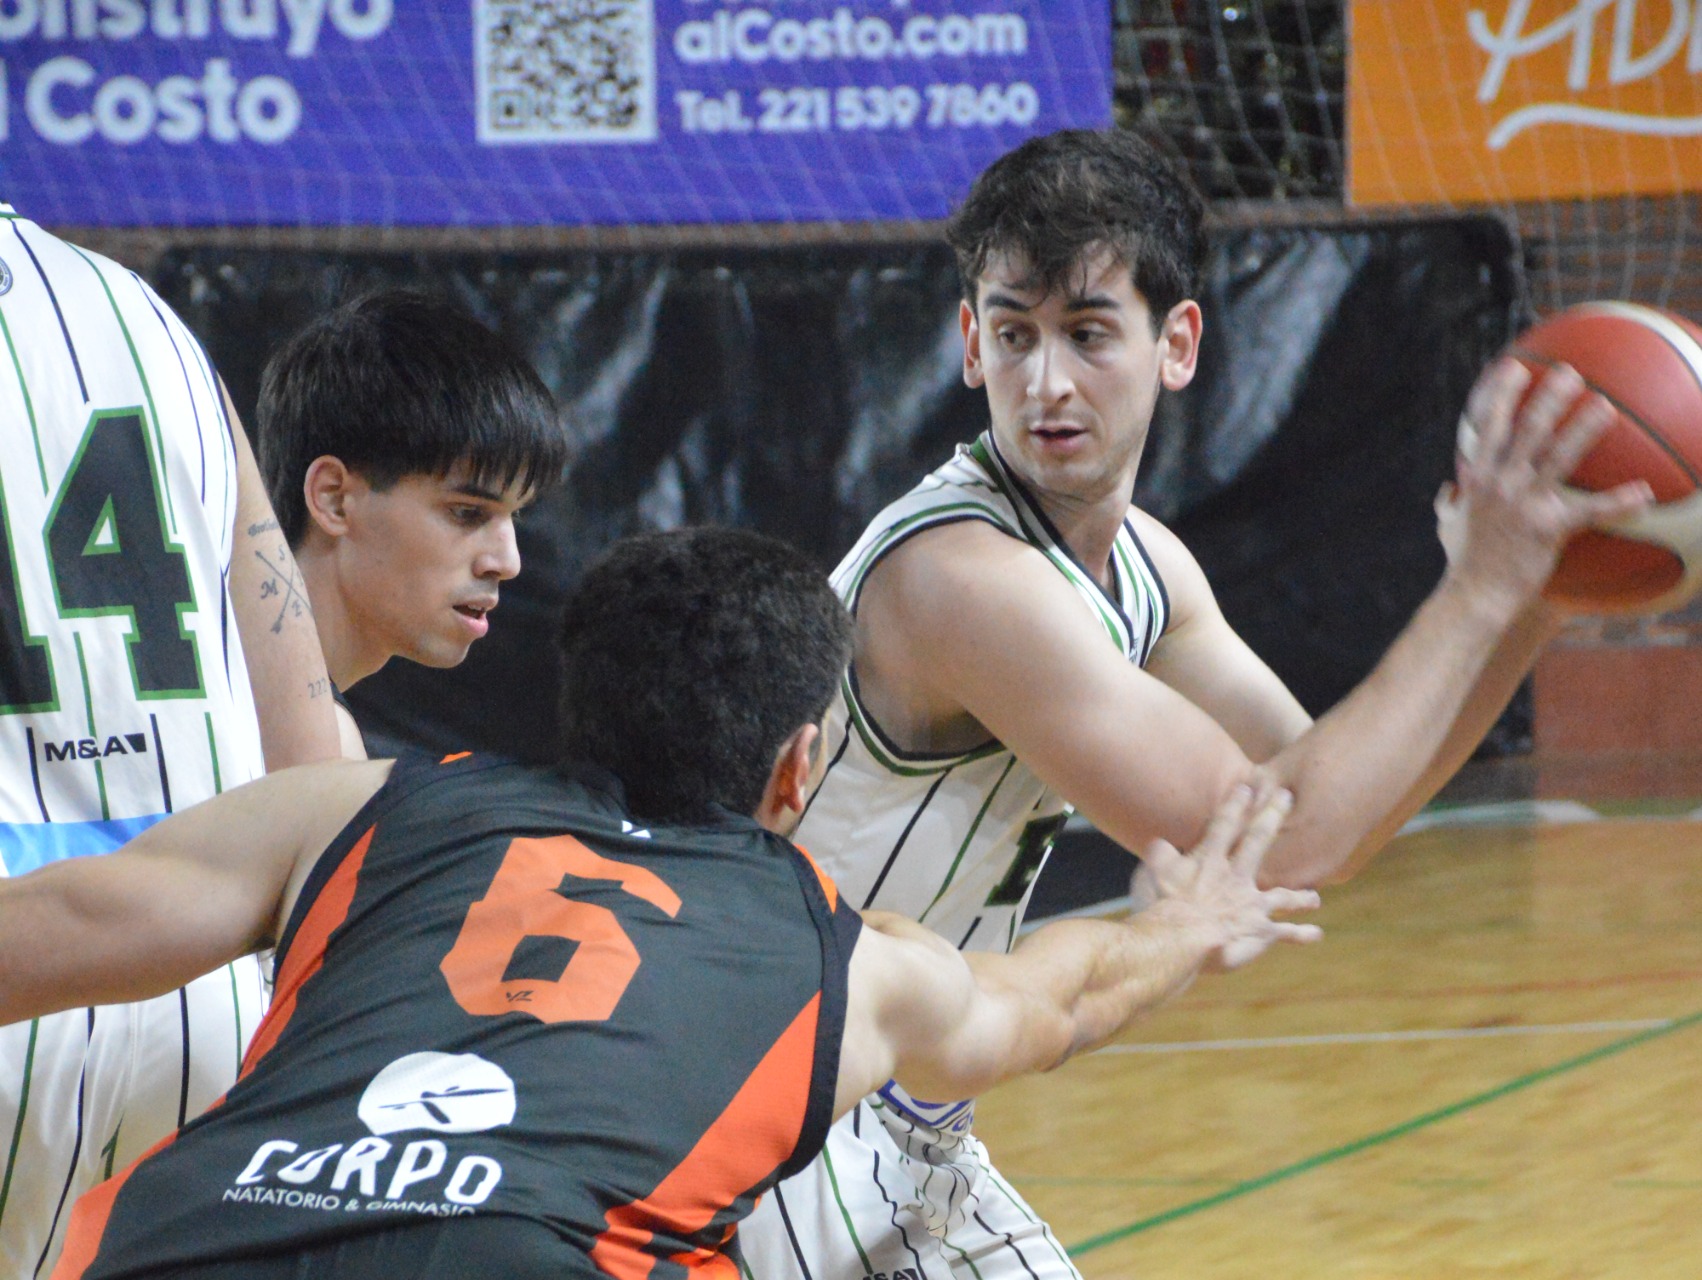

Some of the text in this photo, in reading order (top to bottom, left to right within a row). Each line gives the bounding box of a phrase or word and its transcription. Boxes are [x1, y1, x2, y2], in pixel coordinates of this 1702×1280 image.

[673, 8, 1029, 63] alCosto.com
[25, 55, 303, 145] Costo
[758, 89, 829, 131] 221
[836, 86, 918, 129] 539
[924, 82, 1040, 128] 7860
[439, 834, 683, 1025] 6
[222, 1187, 341, 1211] NATATORIO
[235, 1136, 503, 1205] CORPO
